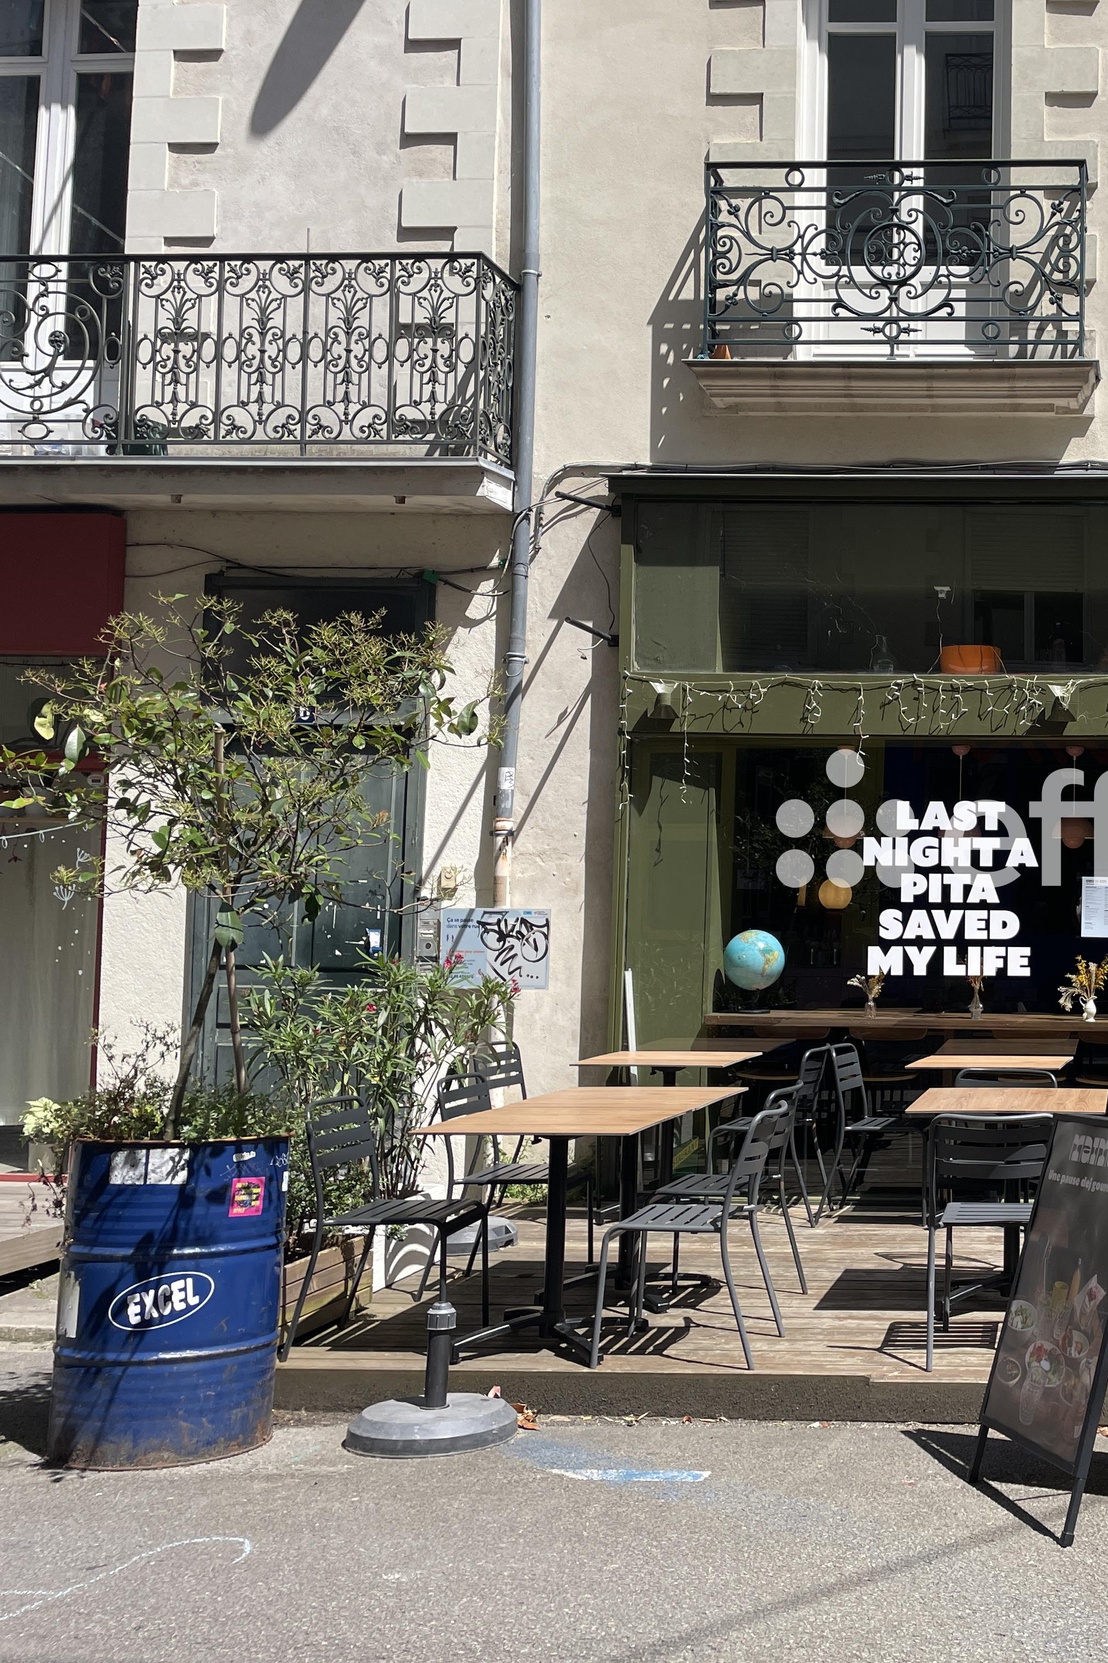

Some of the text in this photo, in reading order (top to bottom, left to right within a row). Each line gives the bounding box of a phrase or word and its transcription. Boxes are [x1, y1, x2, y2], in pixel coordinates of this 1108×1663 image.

[896, 800, 1006, 831] LAST
[863, 837, 1039, 867] NIGHT A
[900, 873, 1000, 903] PITA
[879, 908, 1021, 940] SAVED
[867, 946, 1031, 977] MY LIFE
[1060, 1174, 1080, 1187] pause
[126, 1277, 200, 1325] EXCEL
